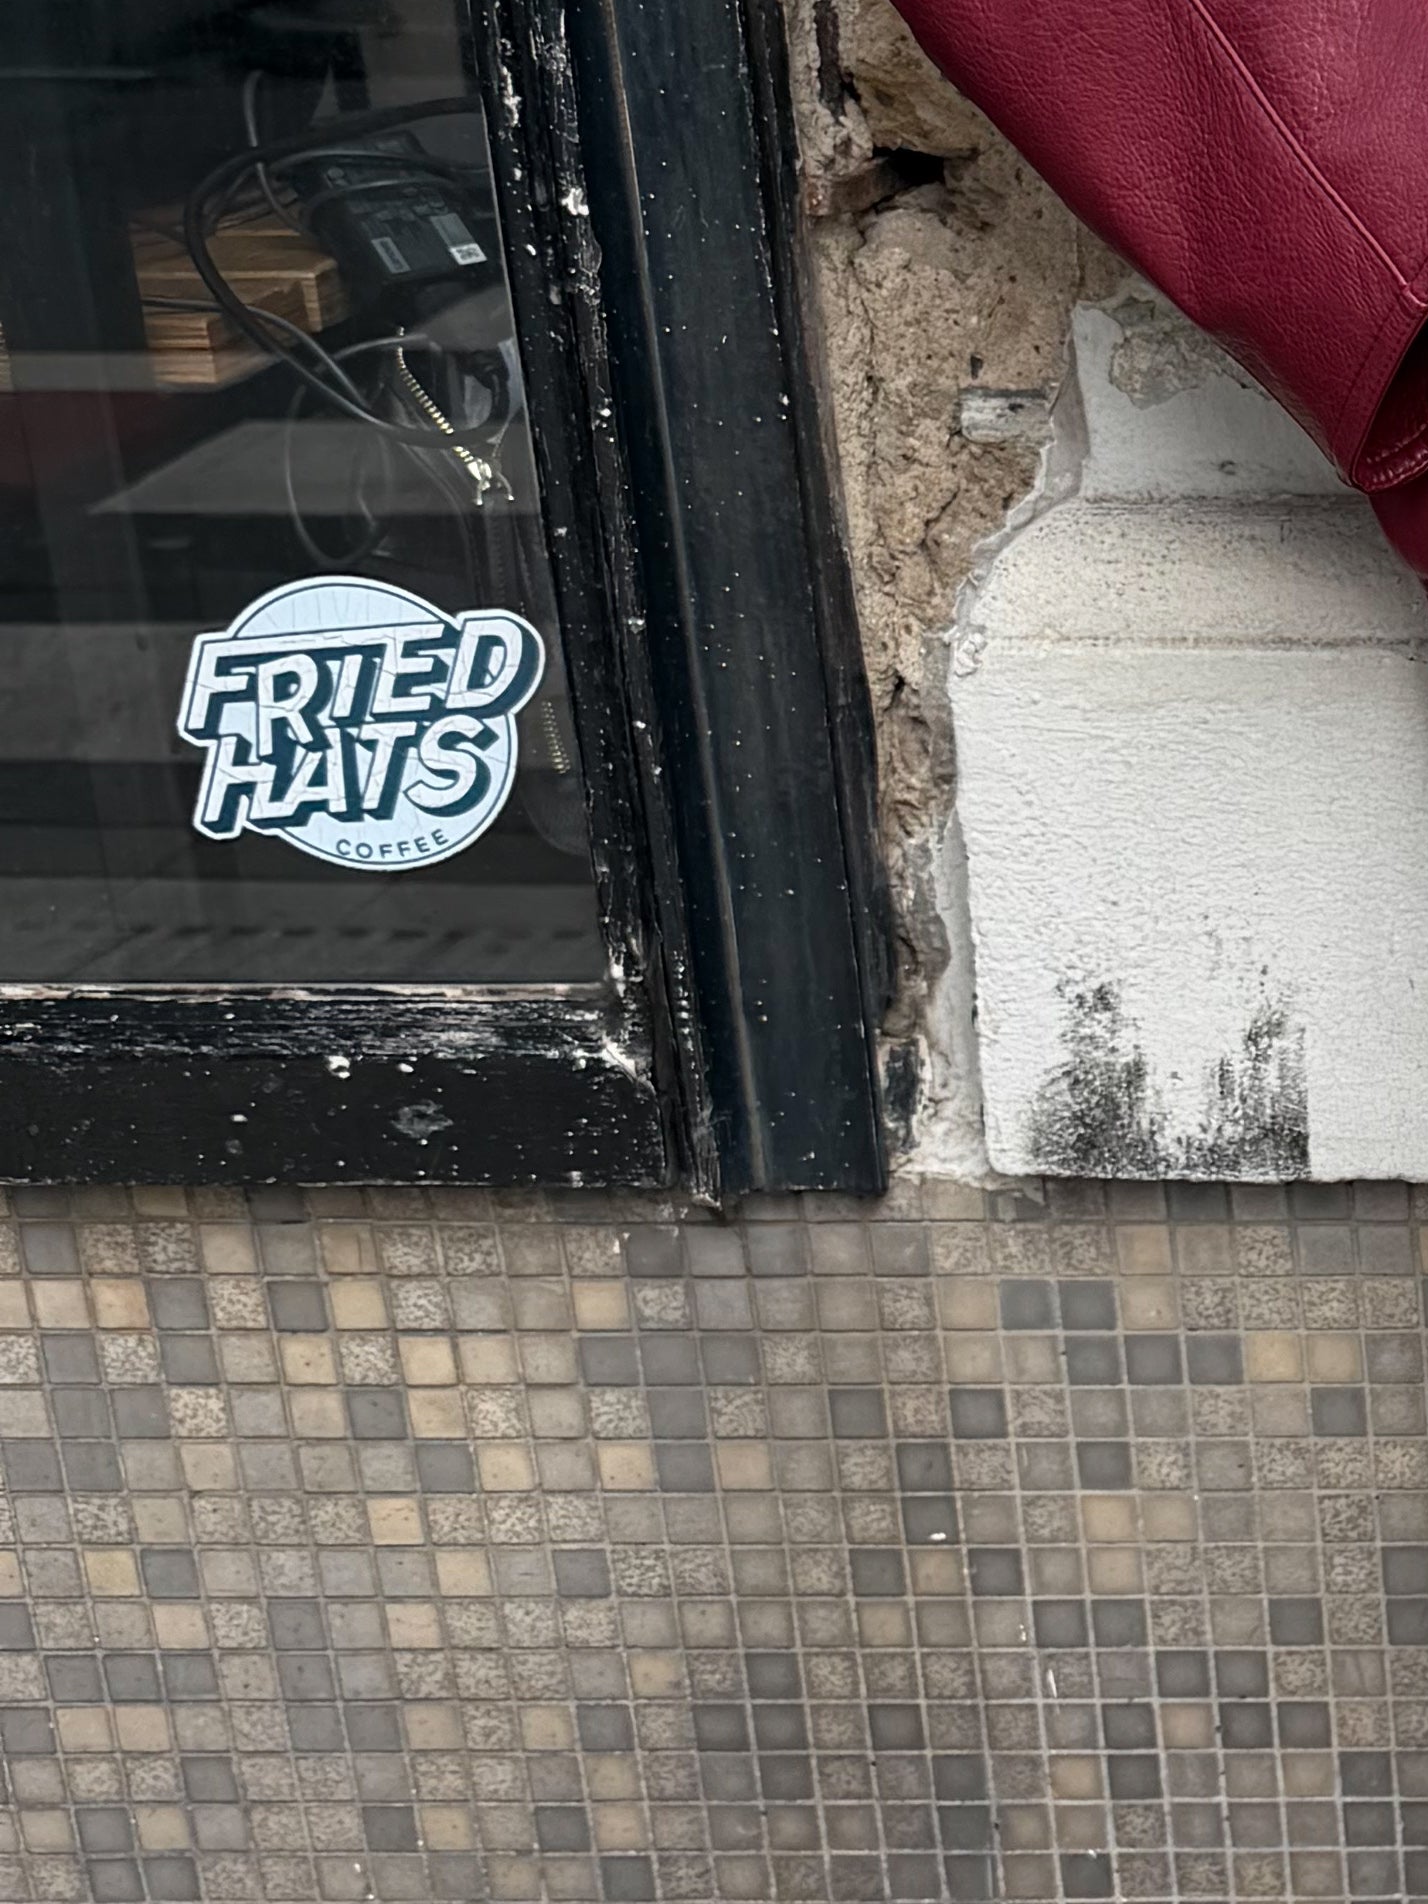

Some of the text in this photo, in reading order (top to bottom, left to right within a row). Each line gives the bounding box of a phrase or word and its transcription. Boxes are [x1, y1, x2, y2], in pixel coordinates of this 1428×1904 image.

[184, 617, 537, 759] FRIED
[201, 714, 497, 833] HATS
[335, 829, 450, 860] COFFEE
